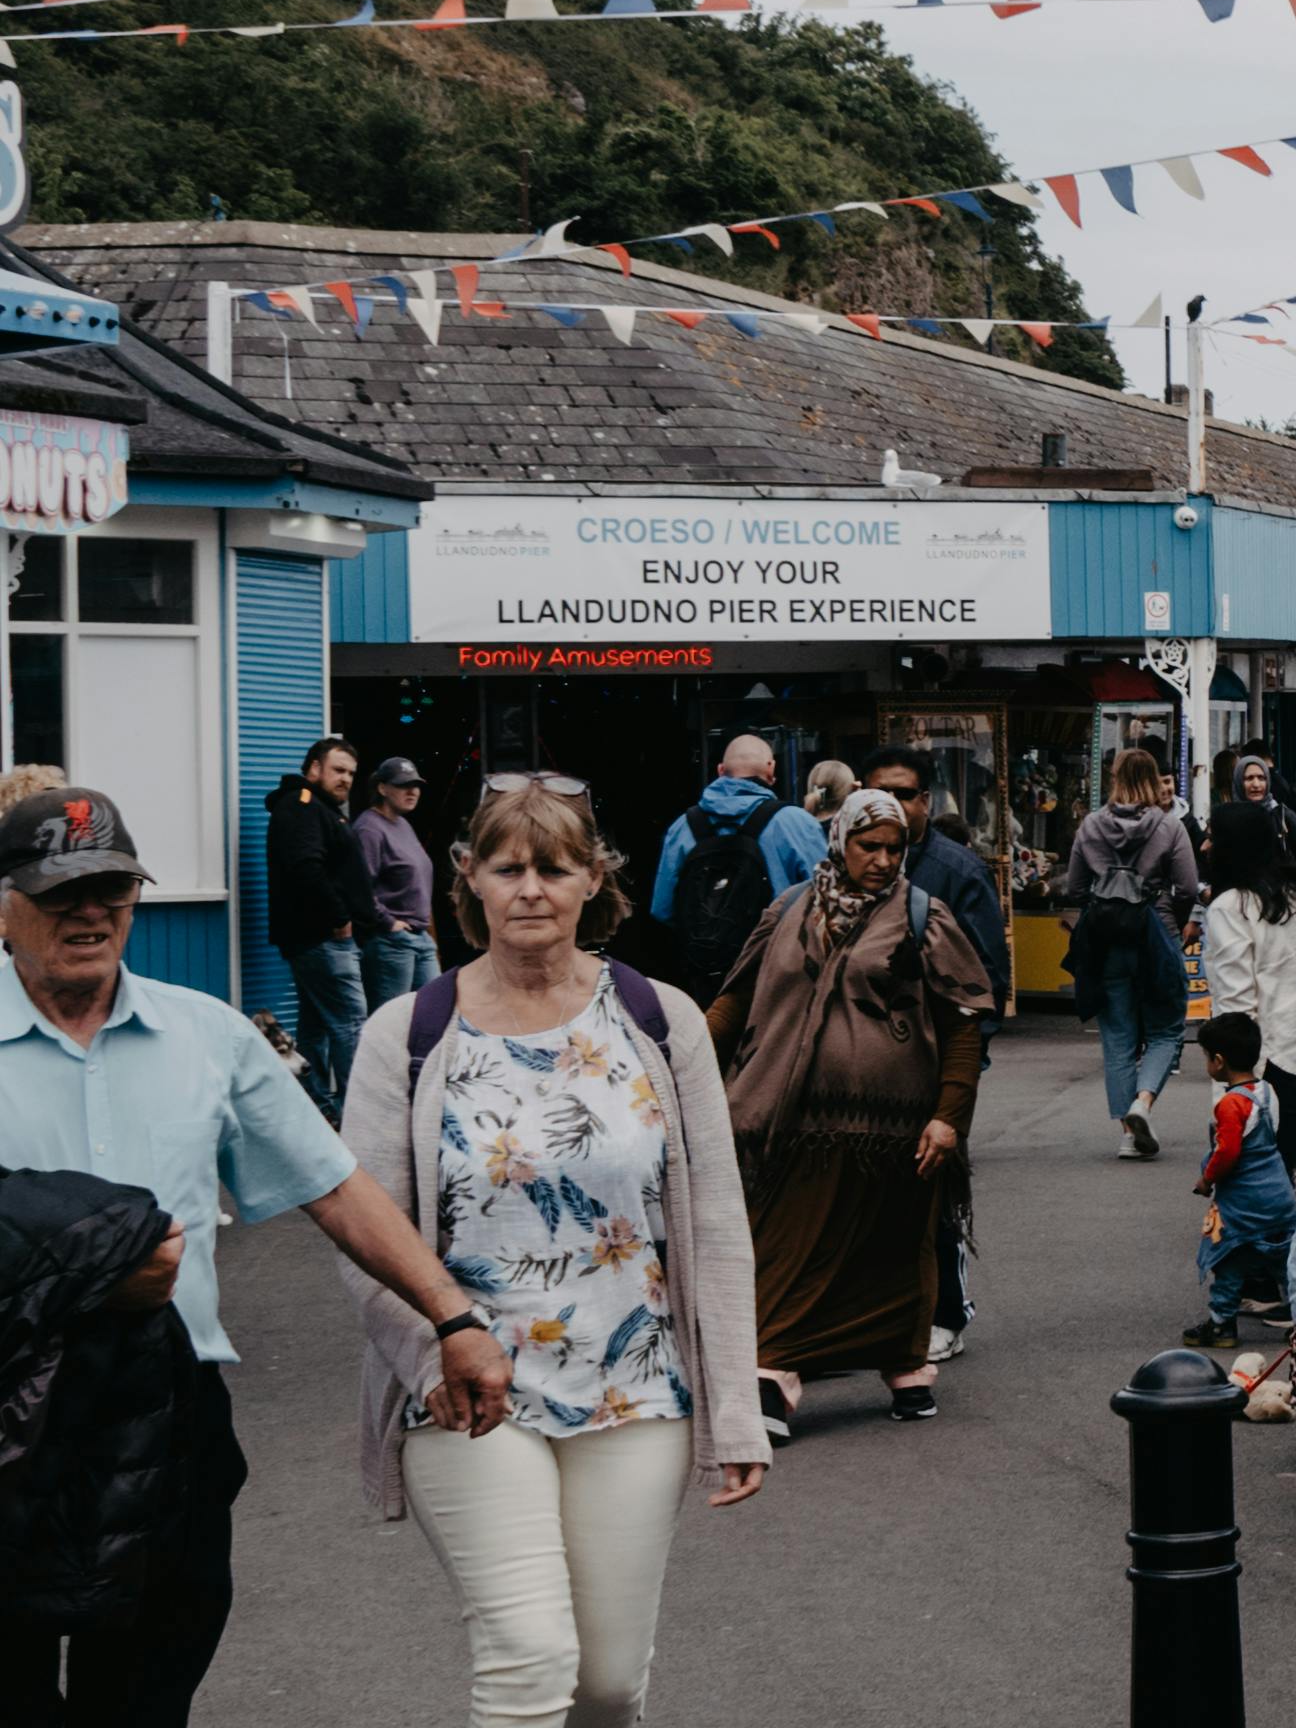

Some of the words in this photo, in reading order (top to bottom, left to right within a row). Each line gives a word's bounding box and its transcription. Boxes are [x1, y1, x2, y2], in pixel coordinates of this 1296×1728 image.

[577, 518, 715, 544] CROESO
[742, 520, 901, 545] WELCOME
[643, 560, 745, 584] ENJOY
[755, 560, 841, 584] YOUR
[498, 600, 697, 623] LLANDUDNO
[709, 600, 778, 623] PIER
[790, 599, 977, 622] EXPERIENCE
[458, 646, 542, 671] Family
[547, 647, 712, 667] Amusements
